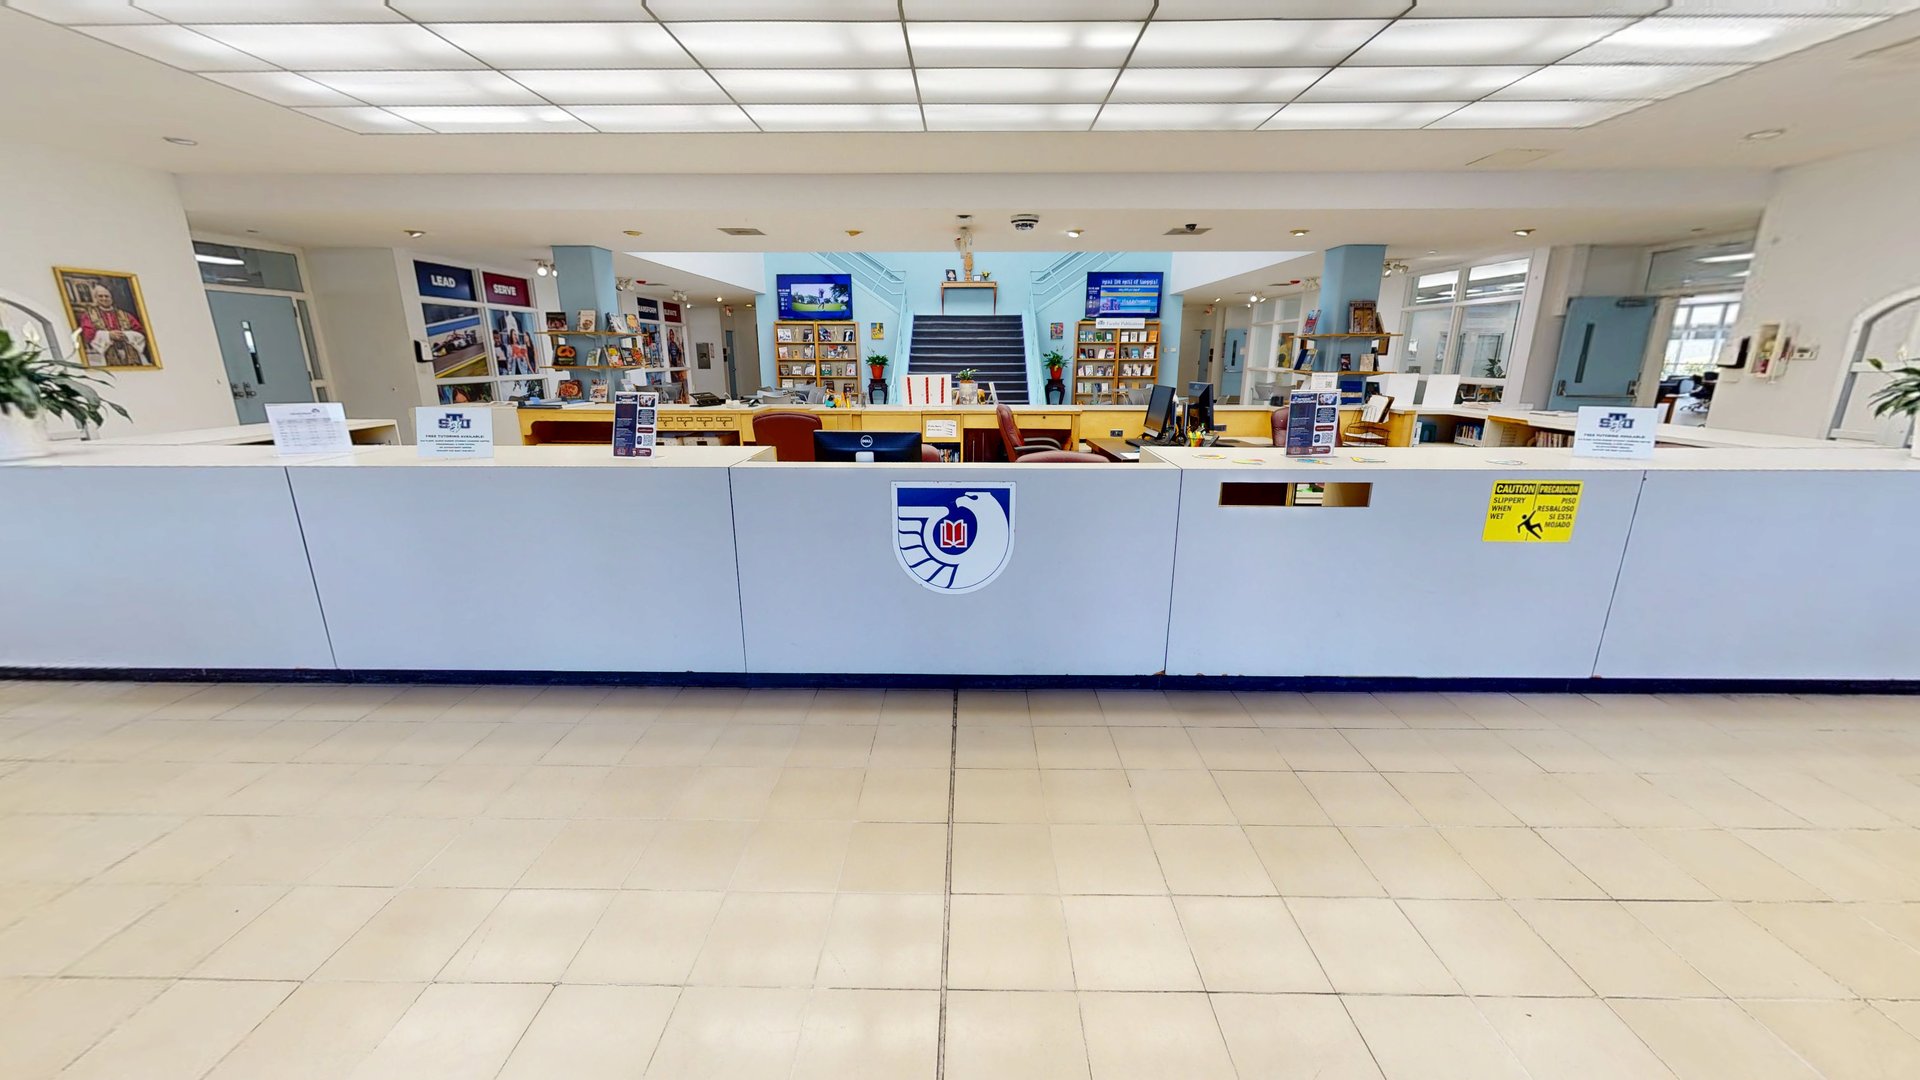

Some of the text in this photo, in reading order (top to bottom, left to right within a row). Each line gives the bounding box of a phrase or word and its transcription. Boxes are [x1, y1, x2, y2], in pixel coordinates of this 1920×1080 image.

[430, 274, 456, 288] LEAD
[493, 283, 517, 296] SERVE
[1496, 484, 1536, 494] CAUTION
[1539, 485, 1579, 494] PRECAUCION
